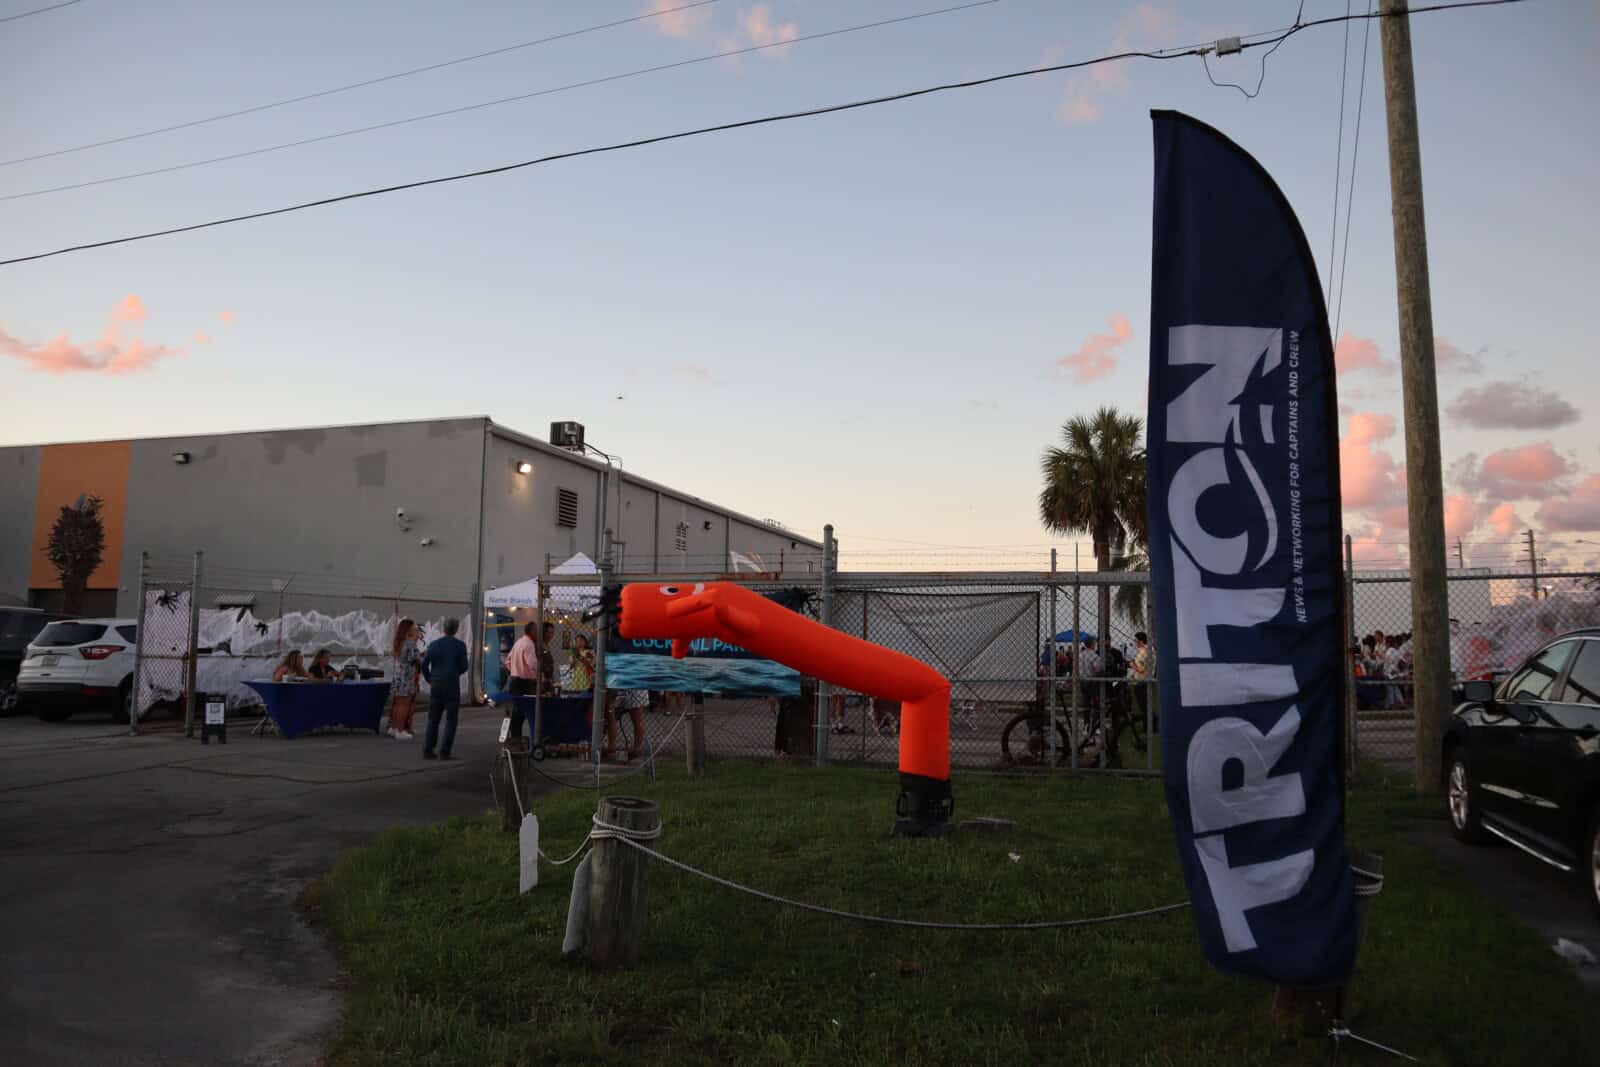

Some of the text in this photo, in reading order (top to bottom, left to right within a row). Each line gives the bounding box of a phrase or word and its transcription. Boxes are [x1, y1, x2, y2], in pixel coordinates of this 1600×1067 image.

[1288, 330, 1308, 623] NEWS & NETWORKING FOR CAPTAINS AND CREW
[632, 638, 710, 651] COCKAIL
[1166, 326, 1314, 952] TRITON
